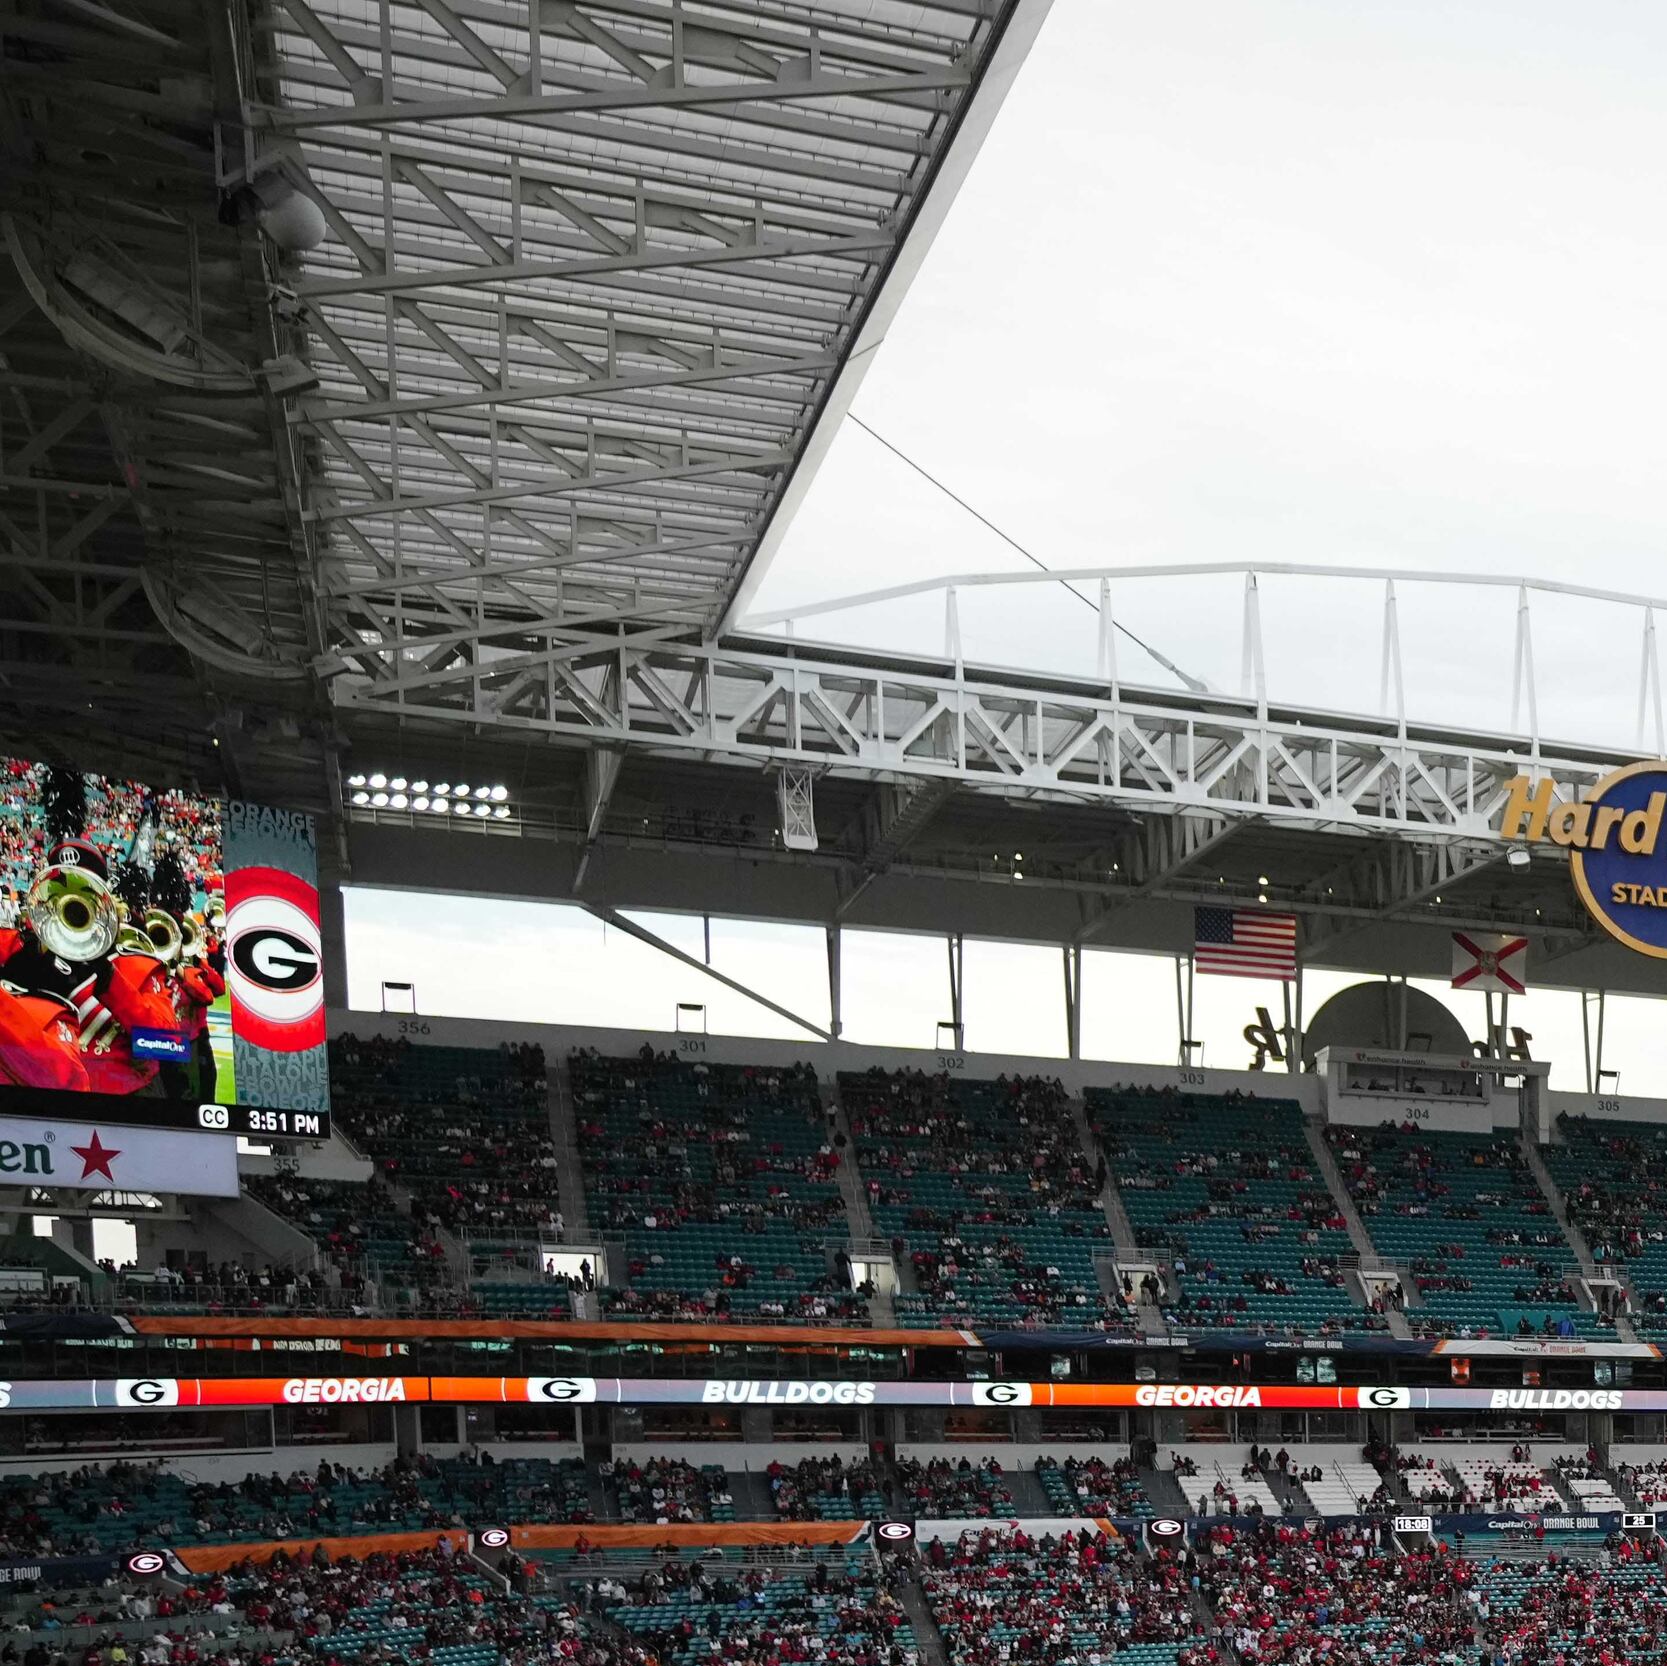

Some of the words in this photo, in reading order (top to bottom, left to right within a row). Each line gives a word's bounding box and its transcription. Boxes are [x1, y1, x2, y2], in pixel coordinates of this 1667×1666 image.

[1503, 775, 1667, 856] Hard
[398, 1020, 431, 1035] 356
[679, 1040, 706, 1053] 301
[938, 1057, 965, 1070] 302
[1179, 1072, 1205, 1085] 303
[1598, 1100, 1620, 1112] 305
[203, 1109, 226, 1125] CC
[1405, 1108, 1430, 1120] 304
[249, 1111, 287, 1133] 3:51
[294, 1114, 319, 1134] PM
[283, 1378, 406, 1403] GEORGIA
[702, 1381, 876, 1404] BULLDOGS
[1135, 1385, 1262, 1407] GEORGIA
[1490, 1390, 1623, 1410] BULLDOGS
[1398, 1519, 1428, 1531] 18:08
[1543, 1517, 1575, 1529] ORANGE
[1576, 1517, 1600, 1529] BOWL
[1632, 1515, 1644, 1526] 25
